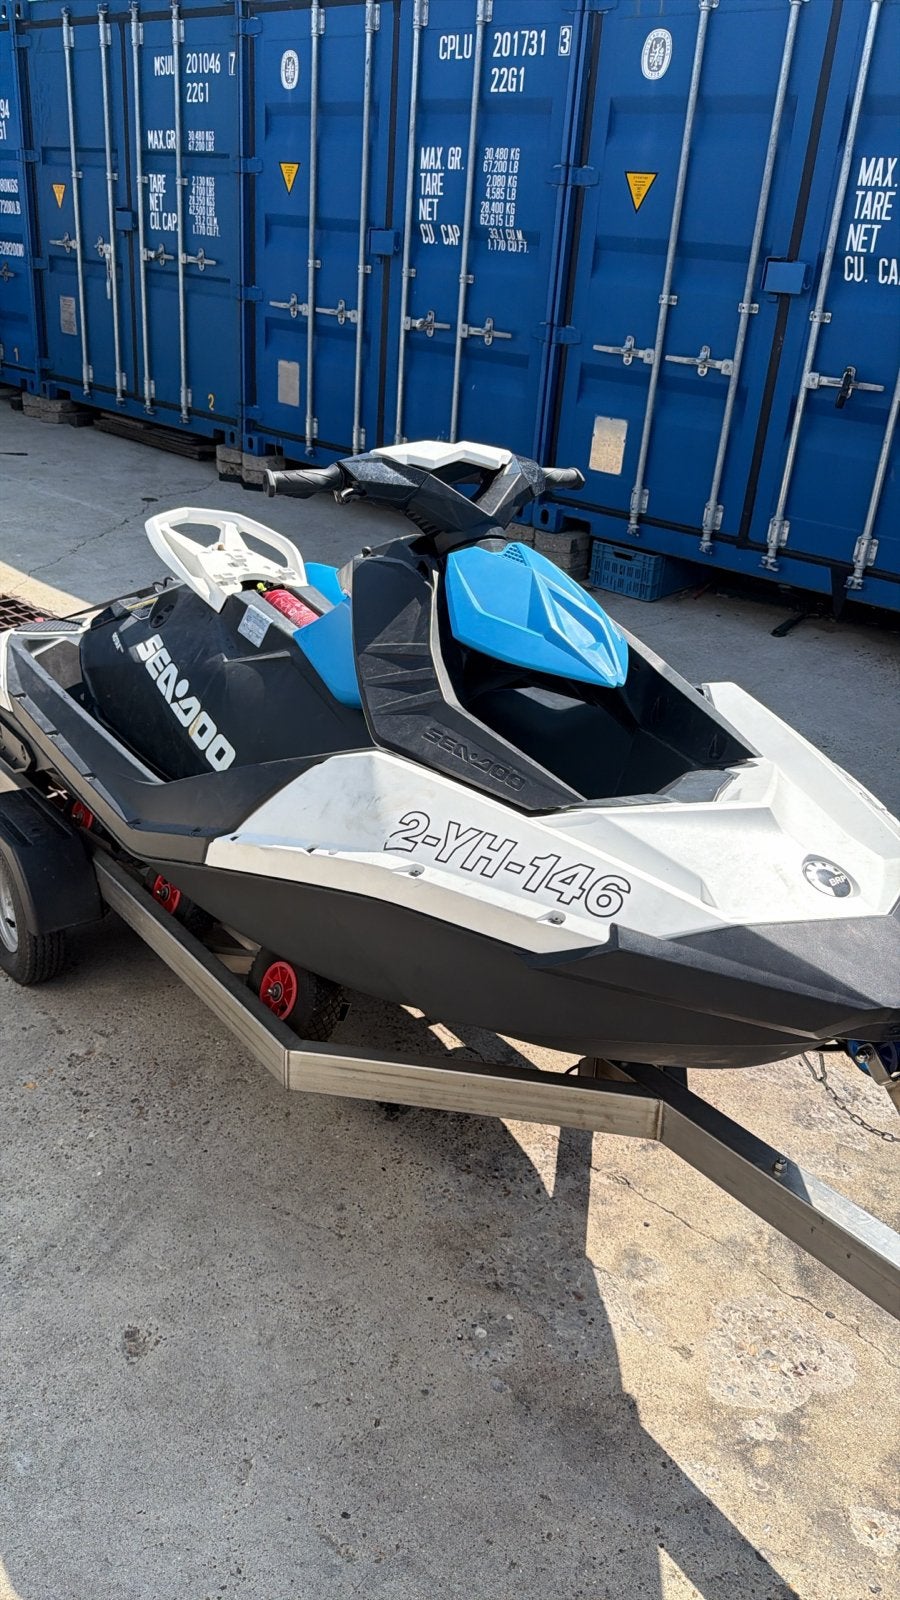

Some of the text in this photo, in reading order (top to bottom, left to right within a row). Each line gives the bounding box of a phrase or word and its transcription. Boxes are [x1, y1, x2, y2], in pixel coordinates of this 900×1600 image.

[439, 27, 571, 60] CPLU 201731 3
[186, 53, 220, 74] 201046
[229, 53, 236, 75] 7
[491, 67, 524, 92] 22G1
[186, 83, 208, 102] 22G1
[420, 147, 444, 170] MAX.
[448, 148, 464, 170] GR.
[510, 148, 520, 160] KG
[509, 162, 519, 173] LB
[857, 157, 898, 187] MAX.
[149, 174, 166, 193] TARE
[420, 173, 444, 195] TARE
[507, 176, 517, 187] KG
[506, 188, 516, 200] LB
[149, 194, 163, 212] NET
[419, 198, 438, 221] NET
[506, 202, 515, 214] KG
[854, 191, 896, 220] TARE
[150, 212, 161, 230] CU.
[505, 215, 514, 227] LB
[420, 224, 438, 244] CU.
[441, 224, 460, 245] CAP
[845, 223, 881, 253] NET
[844, 256, 868, 283] CU.
[14, 348, 19, 362] 1
[208, 394, 214, 411] 2
[384, 811, 631, 918] 2-YH-146
[828, 876, 846, 886] BRP
